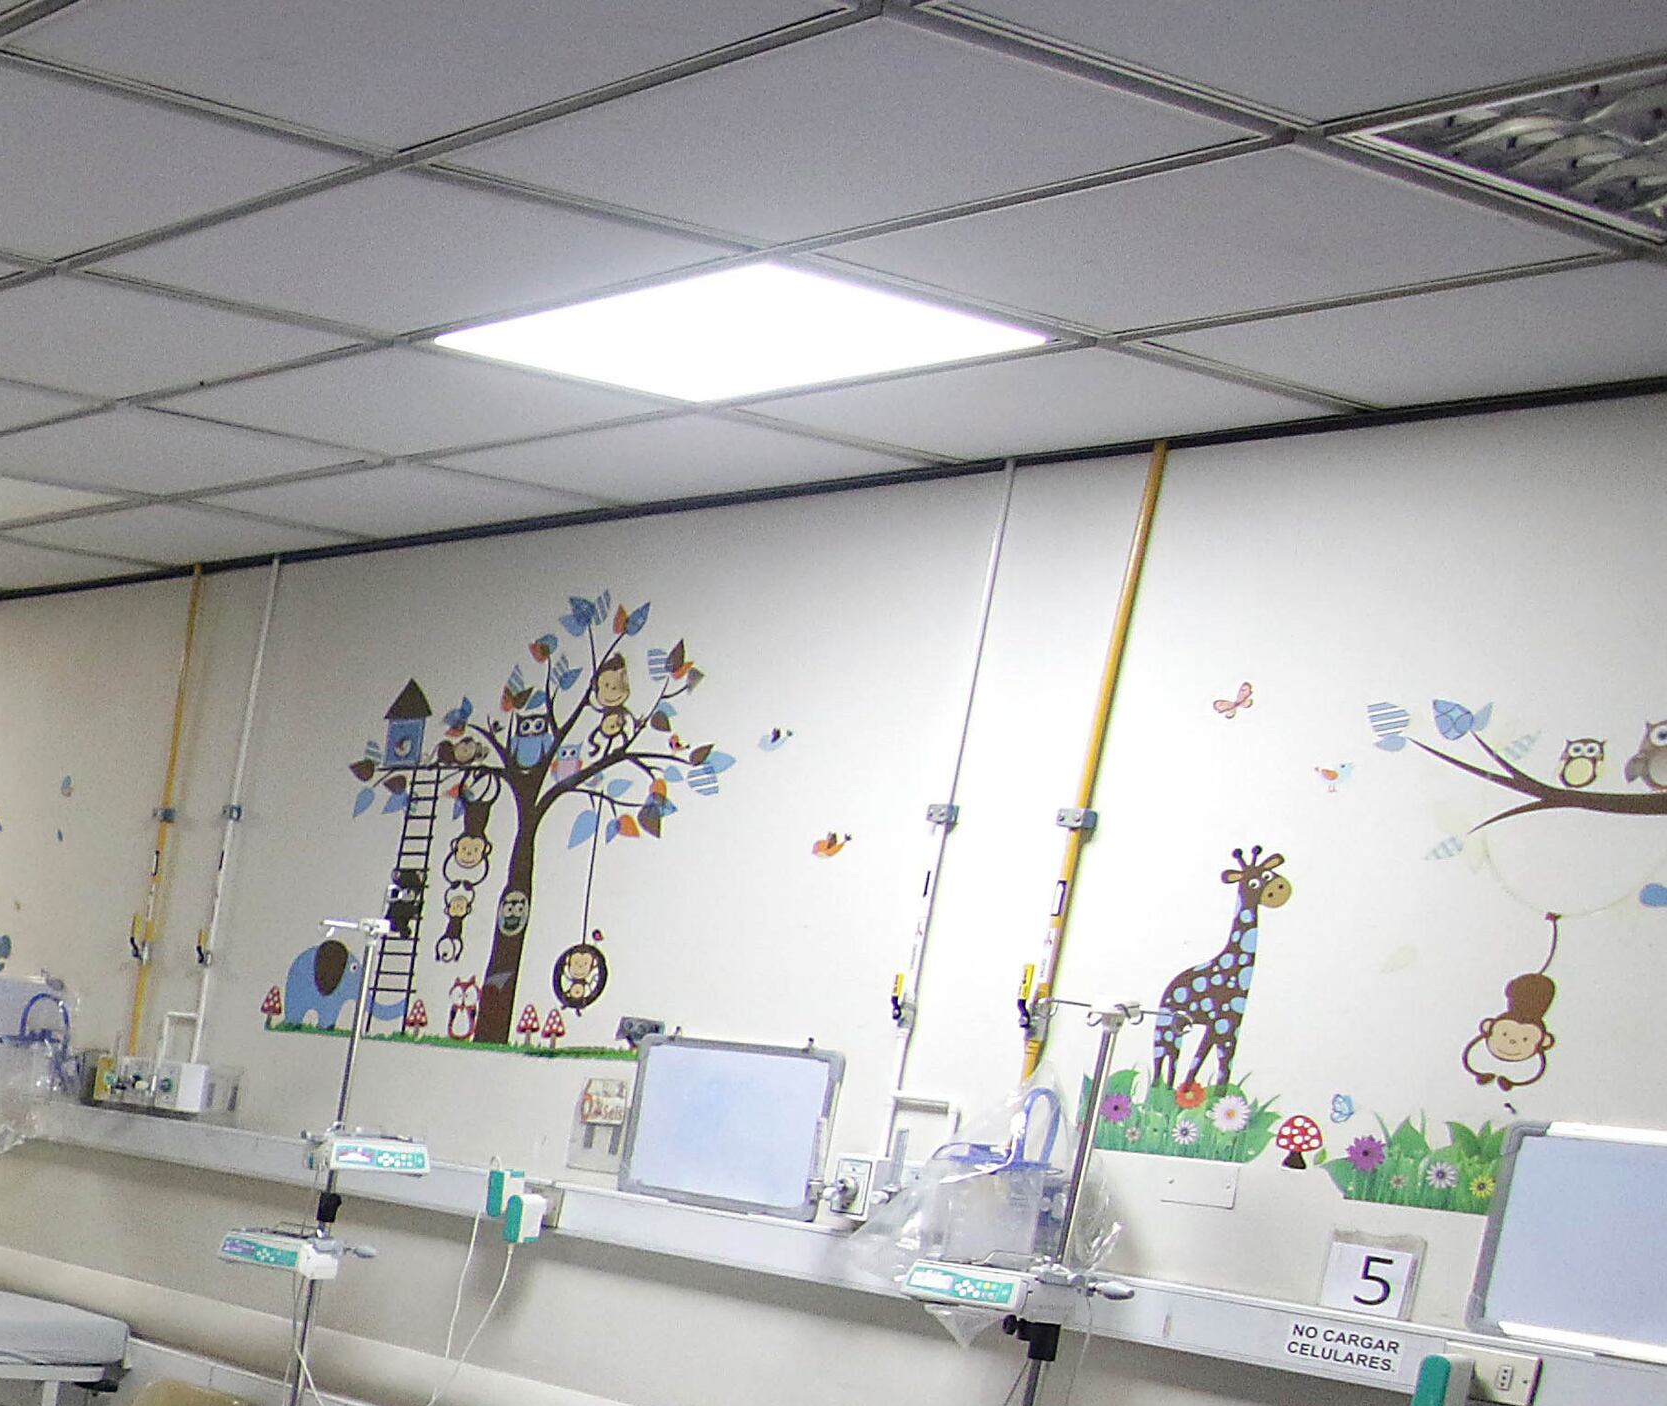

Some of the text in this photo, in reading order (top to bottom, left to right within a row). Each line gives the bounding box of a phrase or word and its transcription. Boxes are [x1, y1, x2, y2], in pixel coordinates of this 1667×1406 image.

[1353, 1255, 1393, 1305] 5
[1292, 1324, 1400, 1354] NO CARGAR
